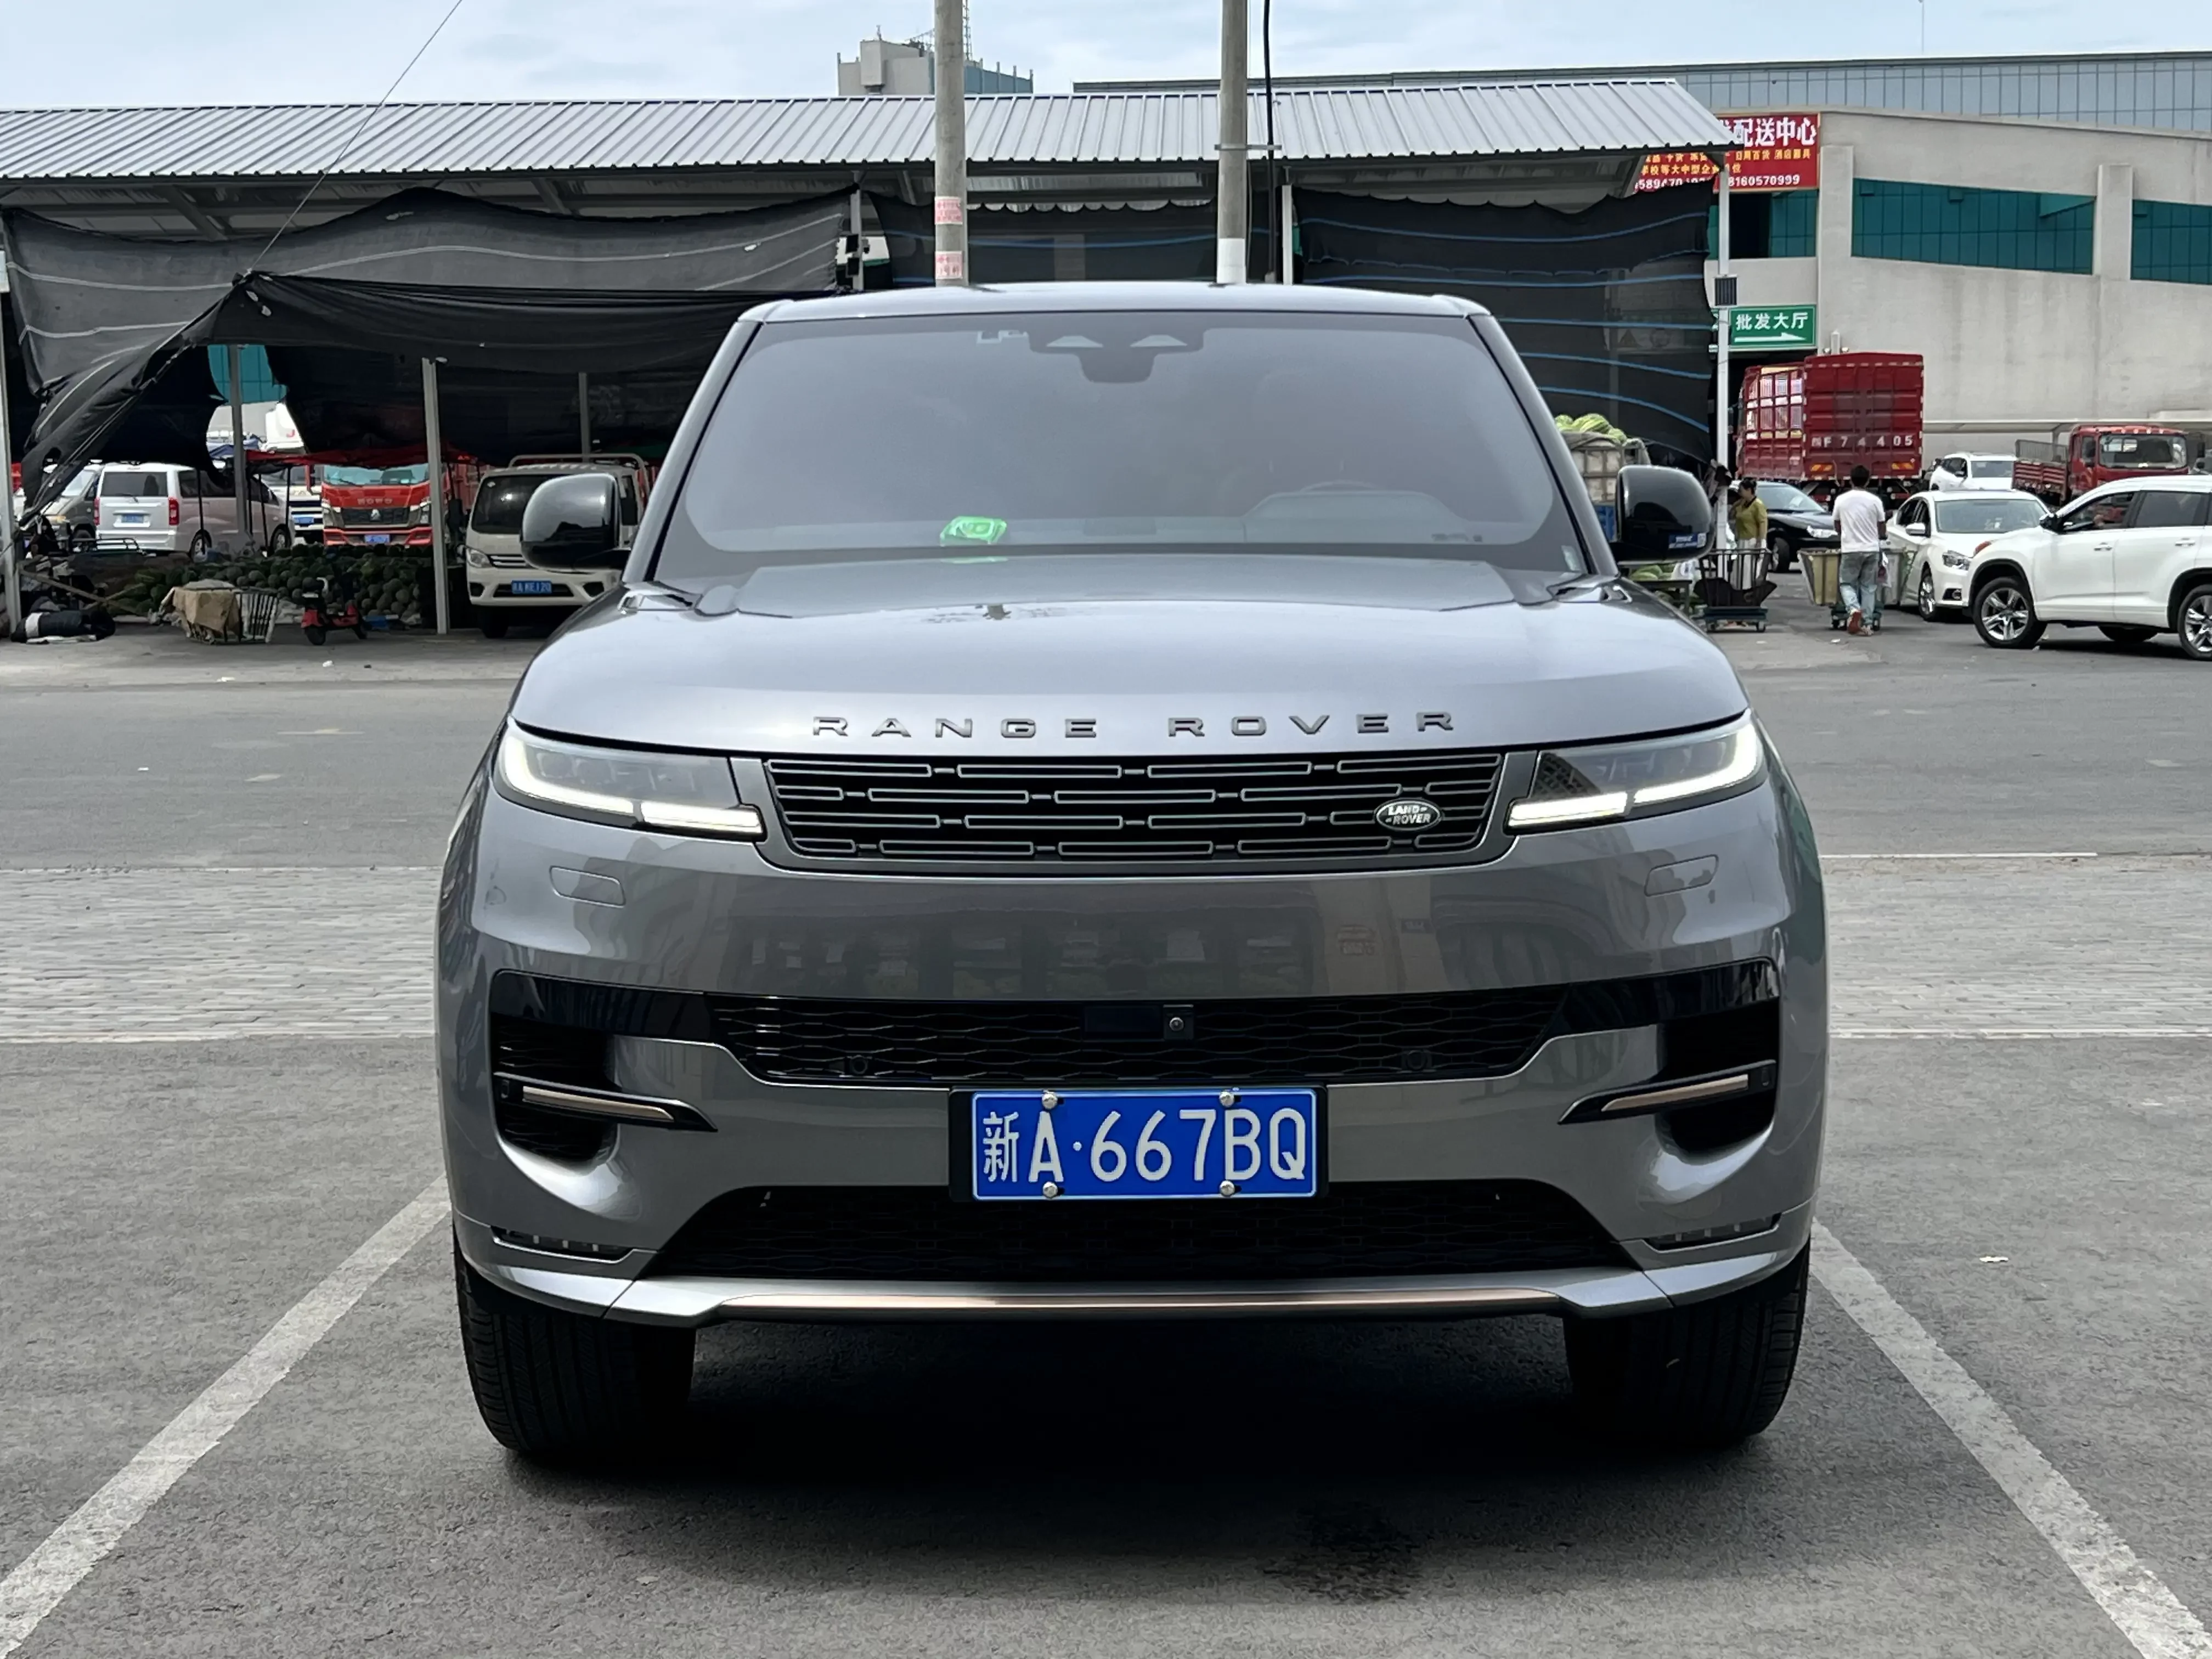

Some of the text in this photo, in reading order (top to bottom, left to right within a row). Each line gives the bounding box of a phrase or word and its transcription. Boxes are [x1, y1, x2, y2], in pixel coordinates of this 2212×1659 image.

[1736, 312, 1808, 330] 批发大厅
[812, 712, 1454, 738] RANGE ROVER
[1388, 805, 1420, 816] LAND
[1392, 813, 1431, 825] ROVER
[983, 1107, 1306, 1182] 新A·667BQ
